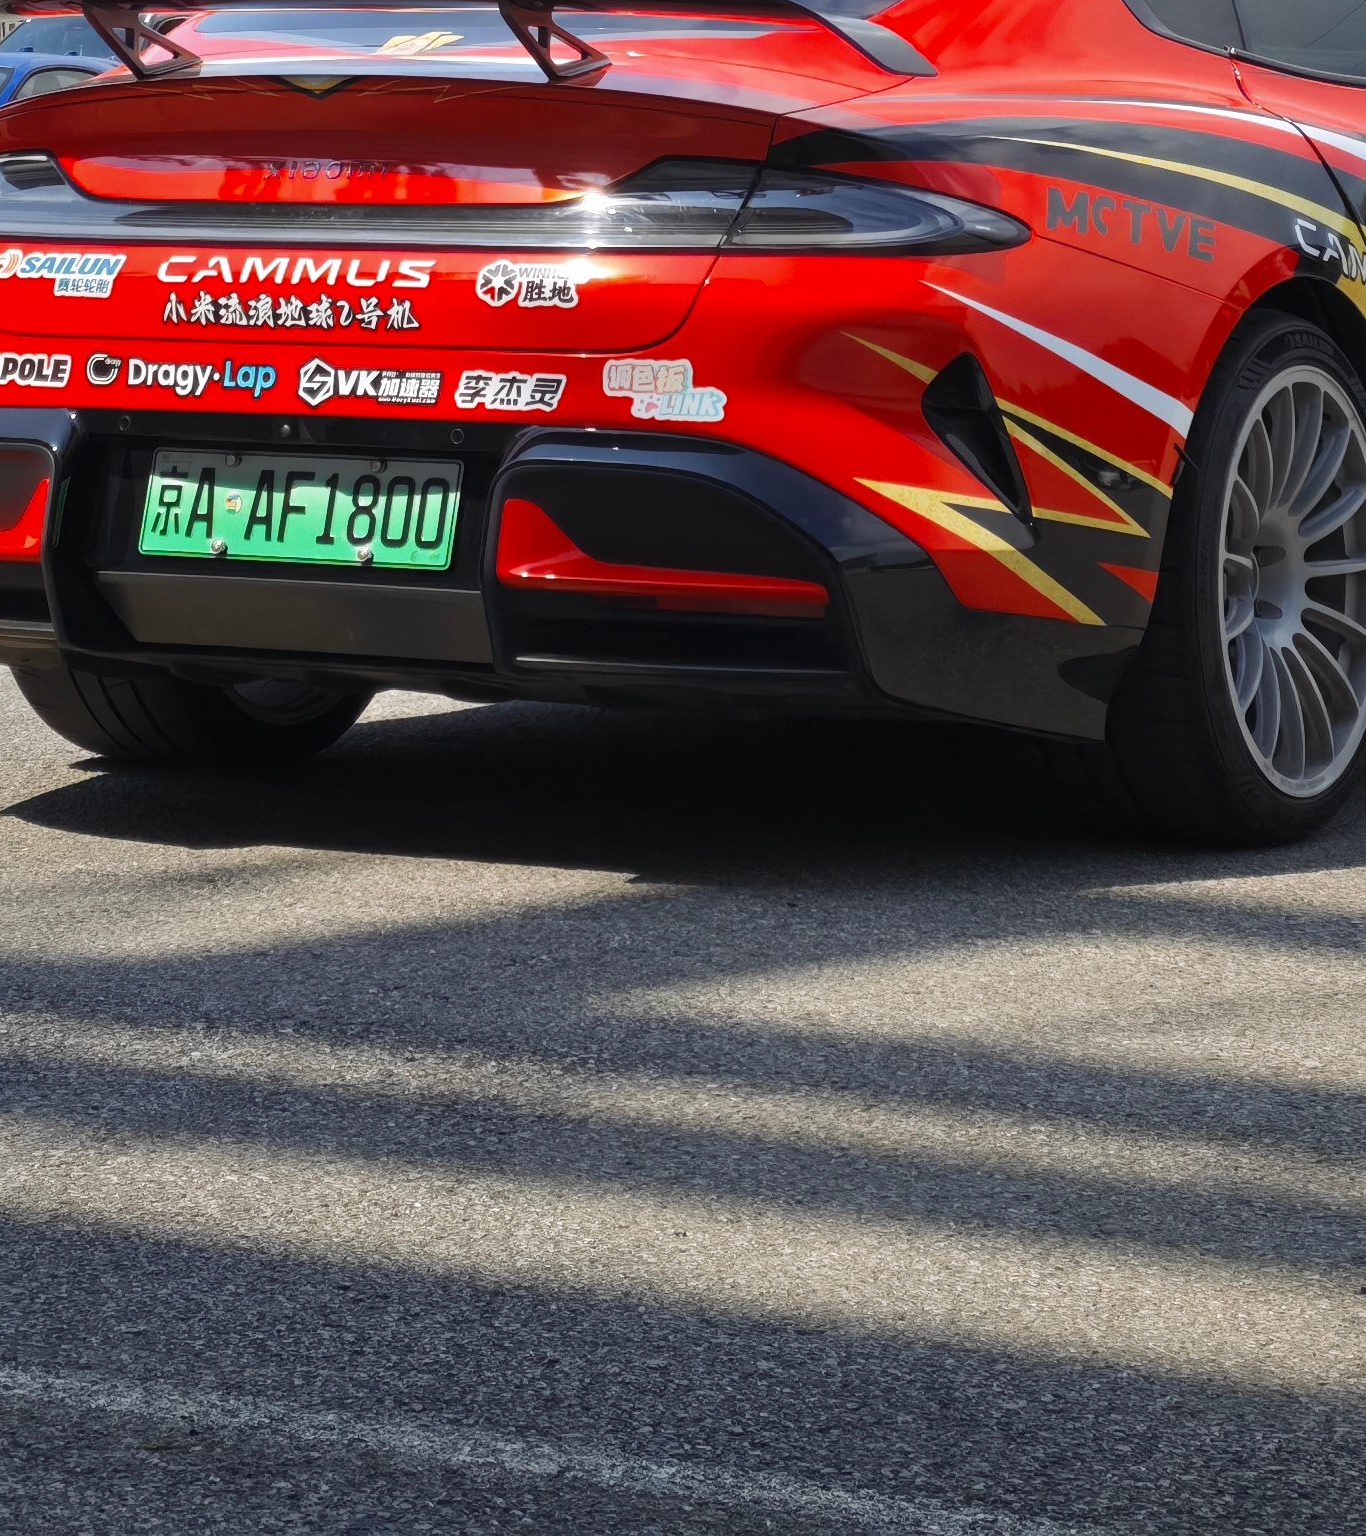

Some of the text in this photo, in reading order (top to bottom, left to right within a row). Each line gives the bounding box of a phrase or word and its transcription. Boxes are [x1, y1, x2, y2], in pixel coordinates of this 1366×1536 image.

[19, 256, 122, 276] SAILUN
[156, 255, 437, 289] CAMMUS
[56, 278, 110, 294] 赛轮轮胎
[522, 279, 575, 304] 胜地
[163, 290, 420, 330] 小米流浪地球2号机
[459, 374, 564, 409] 李杰灵
[150, 465, 451, 549] 京A AF1800
